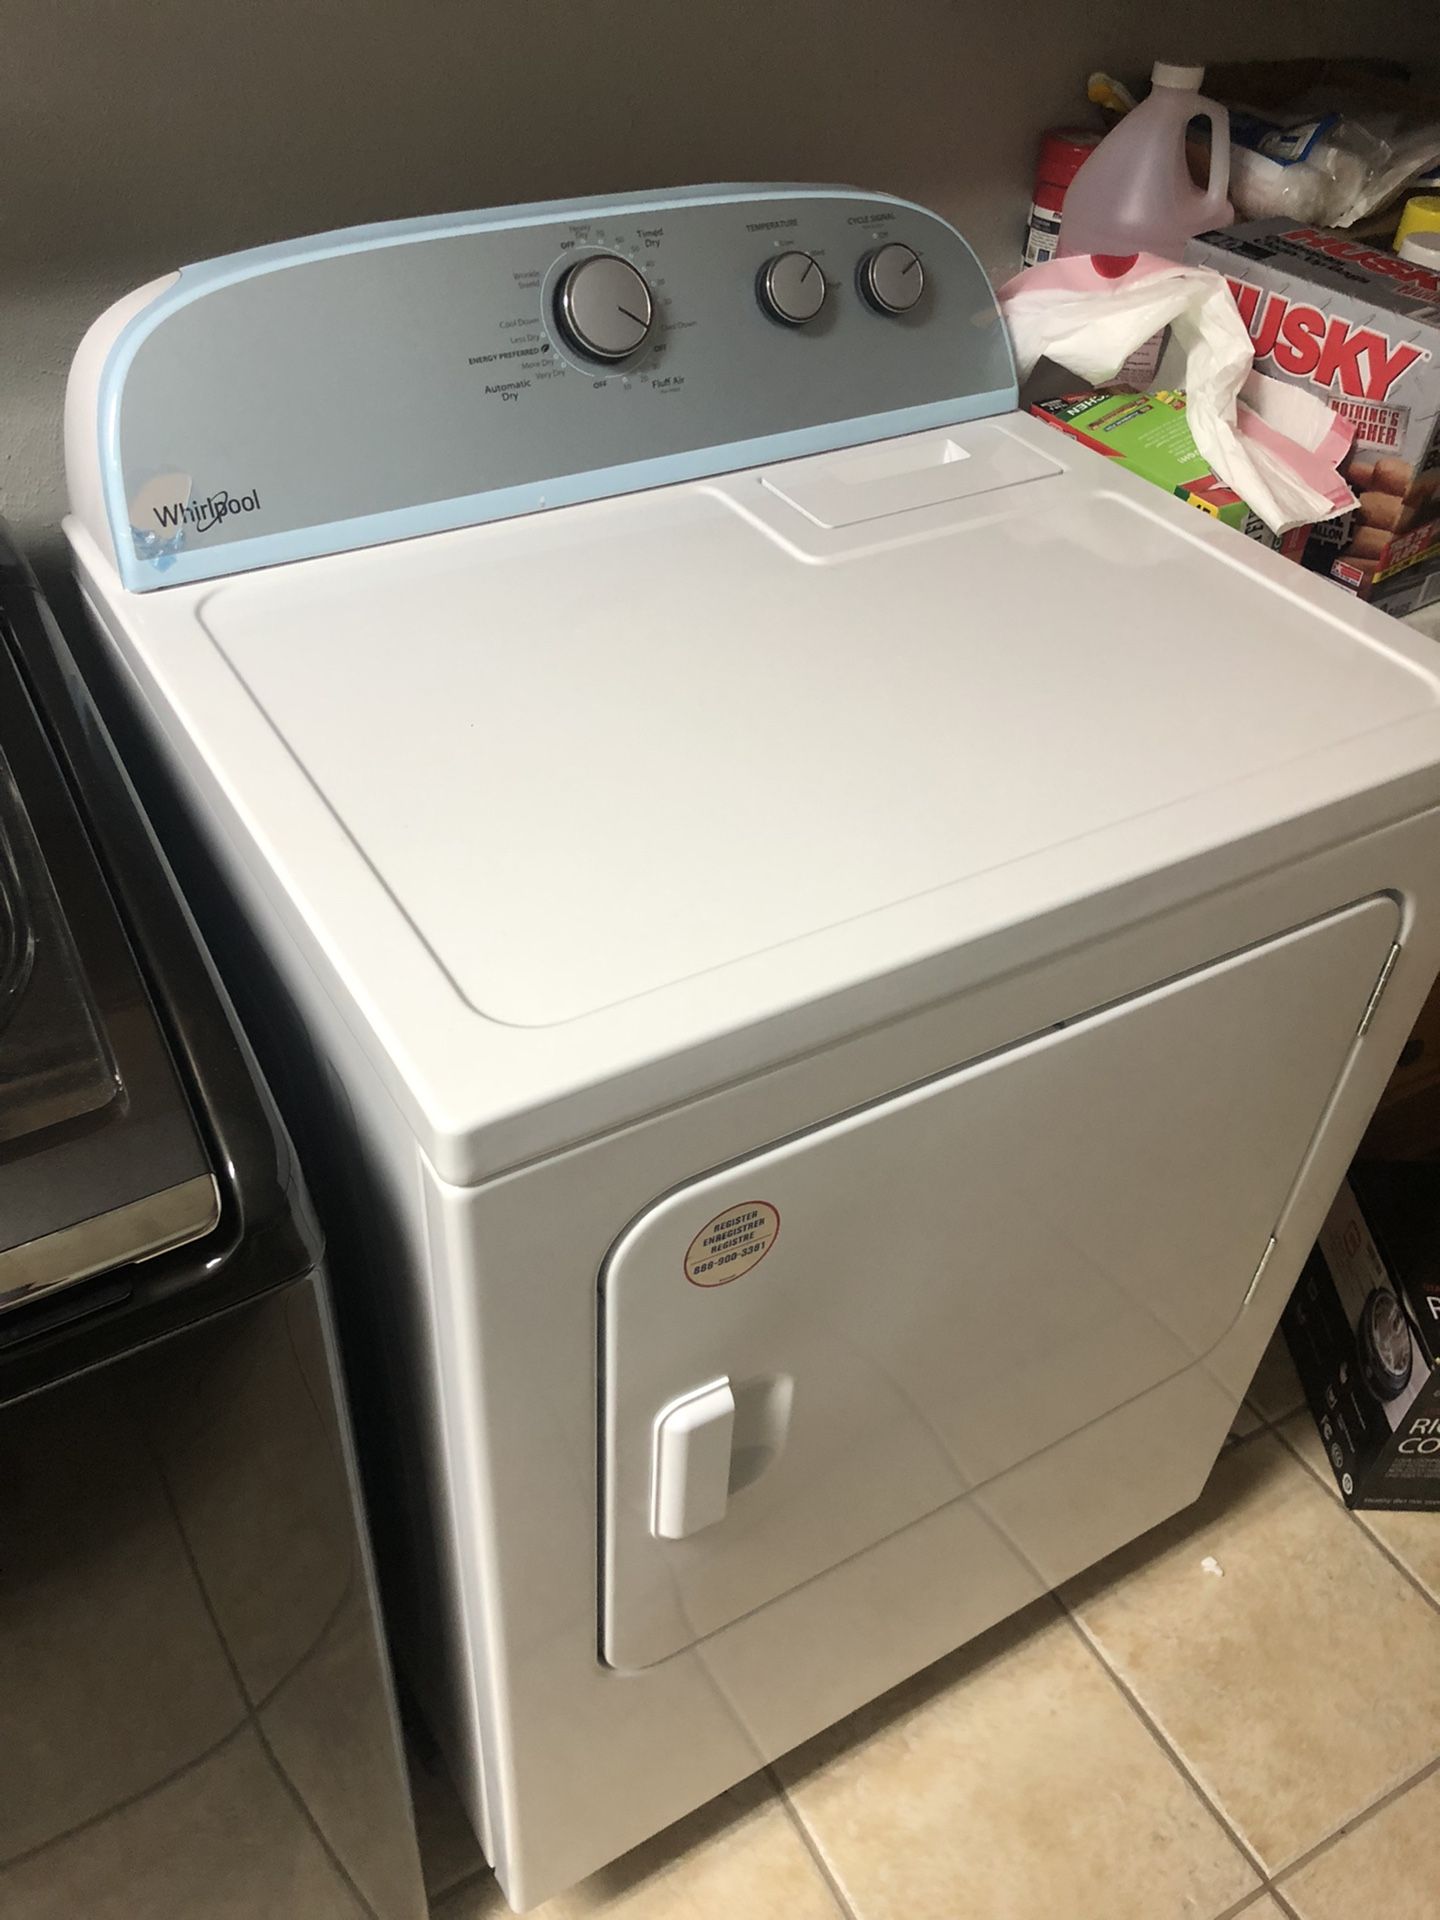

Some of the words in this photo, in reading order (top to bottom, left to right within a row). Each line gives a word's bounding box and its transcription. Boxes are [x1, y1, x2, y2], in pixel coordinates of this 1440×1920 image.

[746, 218, 798, 233] TEMPERATURE
[847, 214, 869, 226] CYCLE
[636, 228, 664, 239] Timed
[560, 241, 576, 250] OFF
[645, 238, 660, 249] Dry
[1280, 229, 1440, 291] HUSK
[499, 319, 517, 329] Cool
[1225, 275, 1424, 403] USKY
[468, 355, 498, 366] ENERGY
[499, 347, 540, 360] PREFERRED
[484, 379, 532, 395] Automatic
[592, 380, 608, 390] OFF
[651, 376, 671, 389] Fluff
[672, 376, 685, 386] Air
[501, 391, 519, 402] Dry
[1331, 400, 1400, 427] NOTHING'S
[153, 489, 261, 533] Whirlpool
[713, 1210, 758, 1233] REGISTER
[702, 1217, 766, 1247] ENREGISTRER
[710, 1230, 755, 1254] REGISTRE
